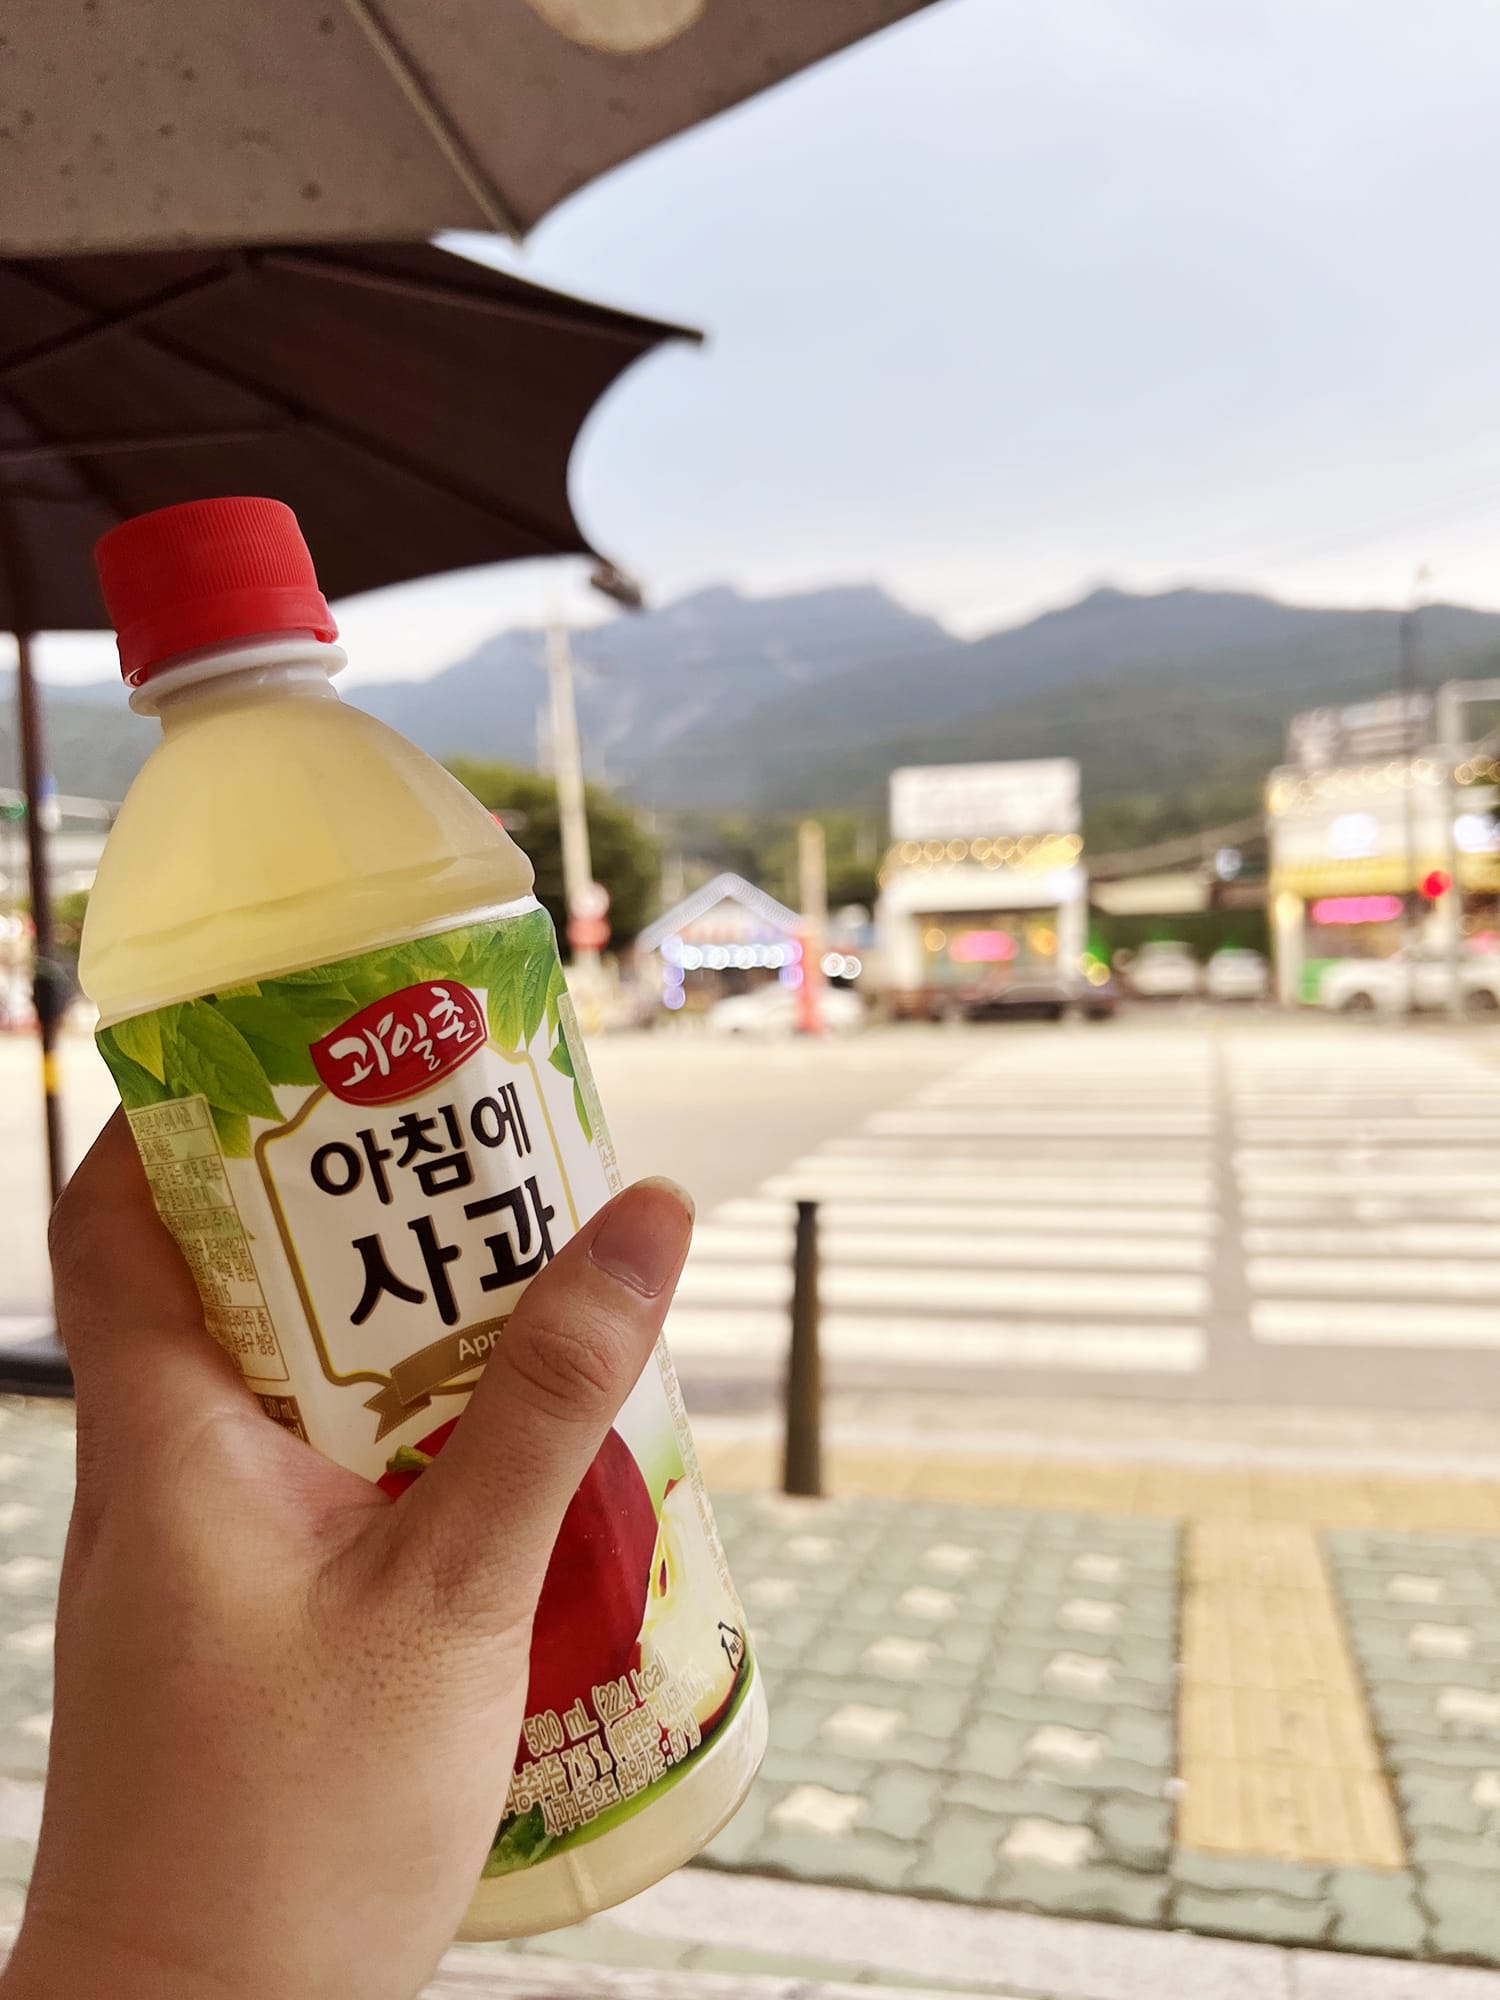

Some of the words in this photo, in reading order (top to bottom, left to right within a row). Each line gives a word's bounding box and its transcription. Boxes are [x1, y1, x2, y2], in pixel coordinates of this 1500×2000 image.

[310, 1081, 532, 1206] 아침에
[350, 1175, 556, 1326] 사과
[523, 1709, 565, 1757] 500
[562, 1697, 600, 1741] mL
[591, 1675, 636, 1727] (224
[629, 1648, 671, 1702] kcal)
[666, 1726, 689, 1763] 50
